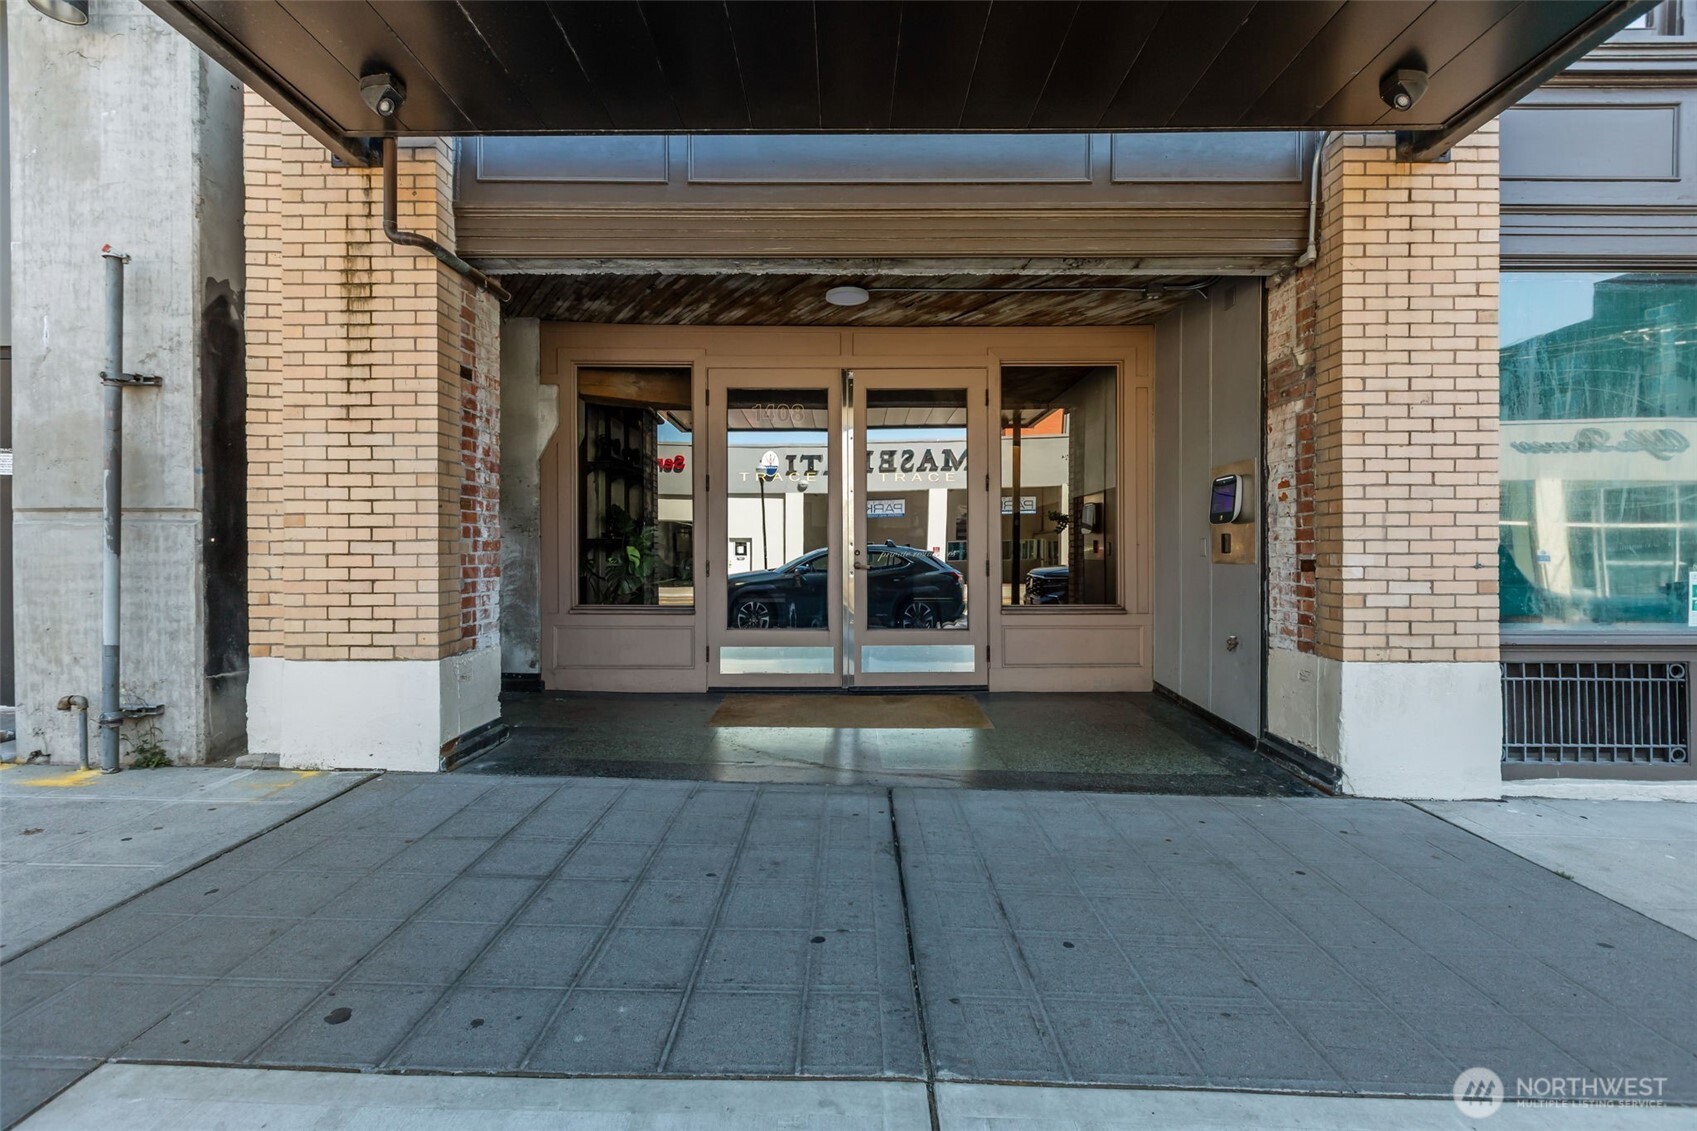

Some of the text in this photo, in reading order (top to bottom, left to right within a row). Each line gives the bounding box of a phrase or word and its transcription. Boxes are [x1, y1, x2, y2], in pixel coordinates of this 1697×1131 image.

[751, 403, 805, 422] 1408
[739, 472, 817, 482] TRACE
[880, 472, 956, 482] TRACE
